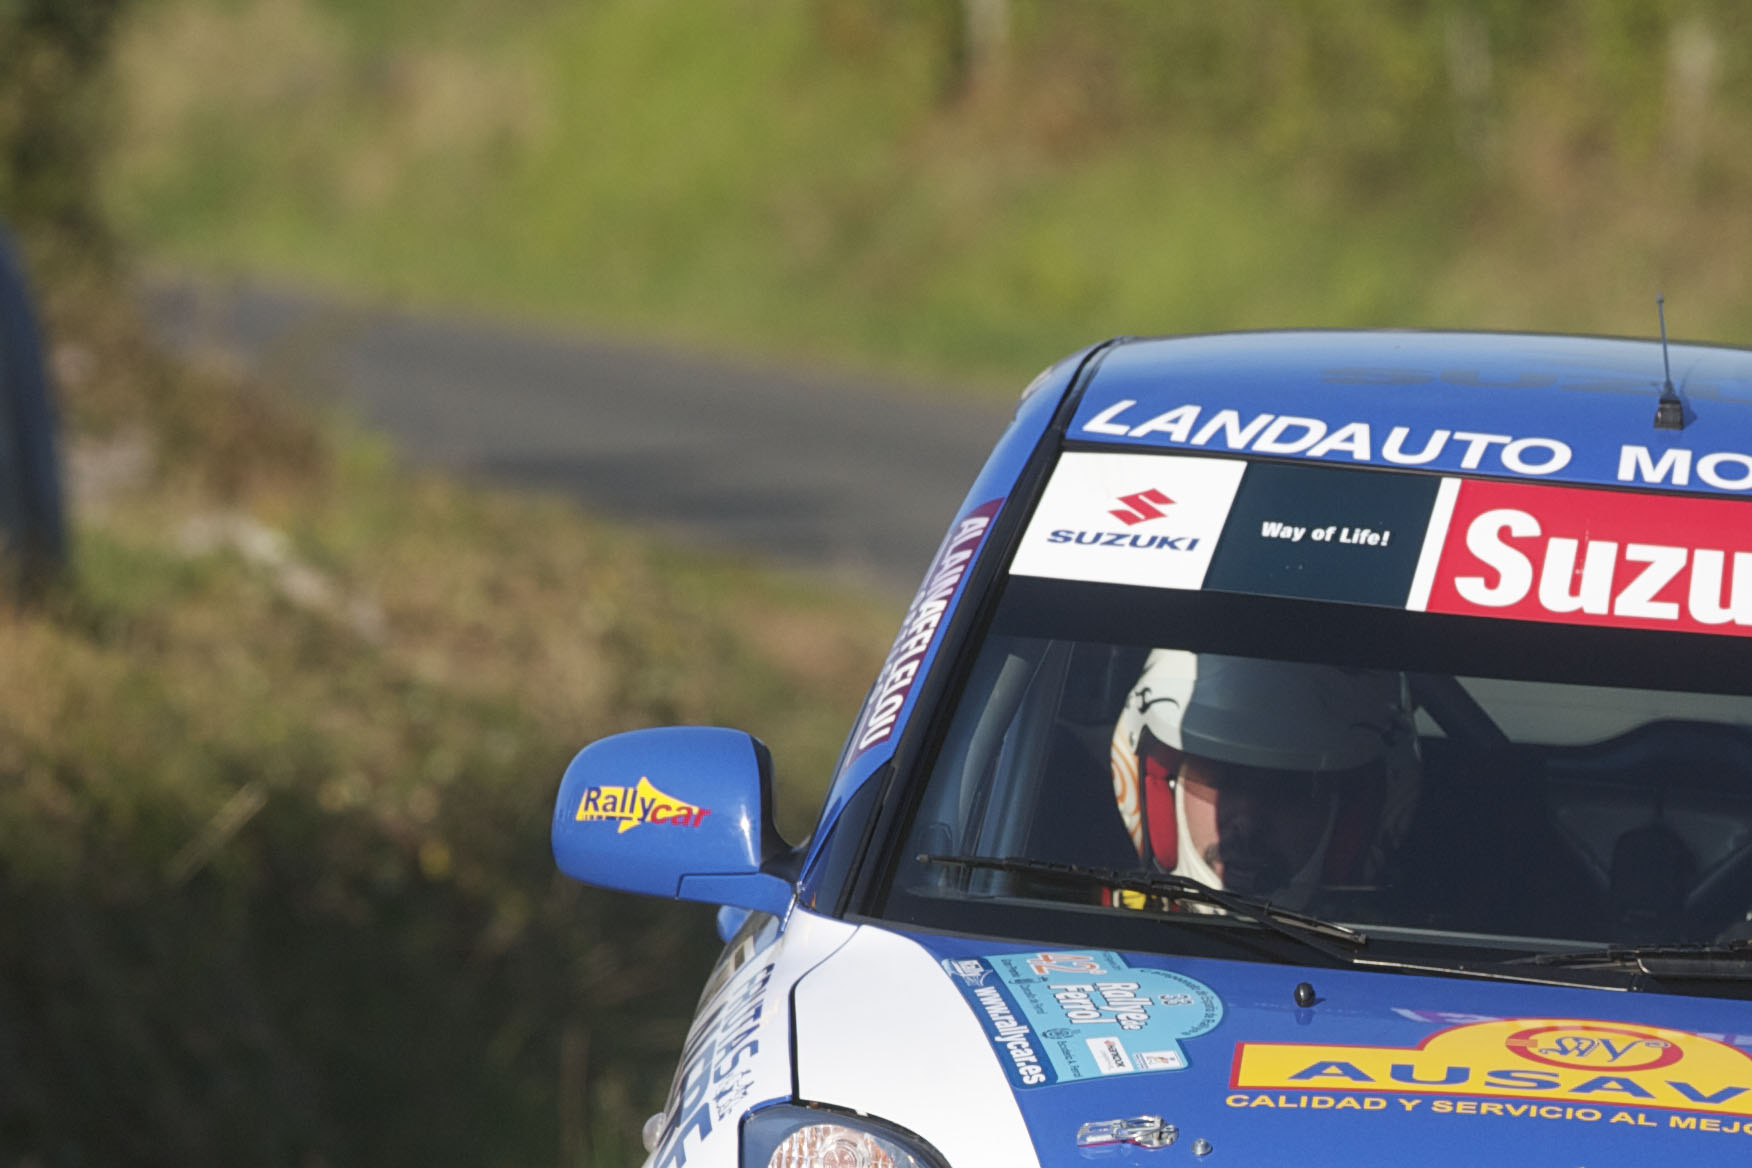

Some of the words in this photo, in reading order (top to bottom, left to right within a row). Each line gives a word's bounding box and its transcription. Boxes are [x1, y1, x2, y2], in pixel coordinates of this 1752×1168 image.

[1083, 400, 1572, 476] LANDAUTO
[1047, 529, 1200, 553] SUZUKI
[1260, 521, 1308, 543] Way
[1311, 526, 1337, 543] of
[1339, 527, 1391, 548] Life!
[583, 786, 712, 829] Rallycar
[1047, 983, 1122, 1025] Ferrol
[974, 985, 1046, 1086] www.rallycar.es
[1224, 1094, 1388, 1110] CALIDAD
[1399, 1098, 1422, 1112] Y
[1431, 1100, 1603, 1122] SERVICIO
[1610, 1111, 1658, 1126] AL
